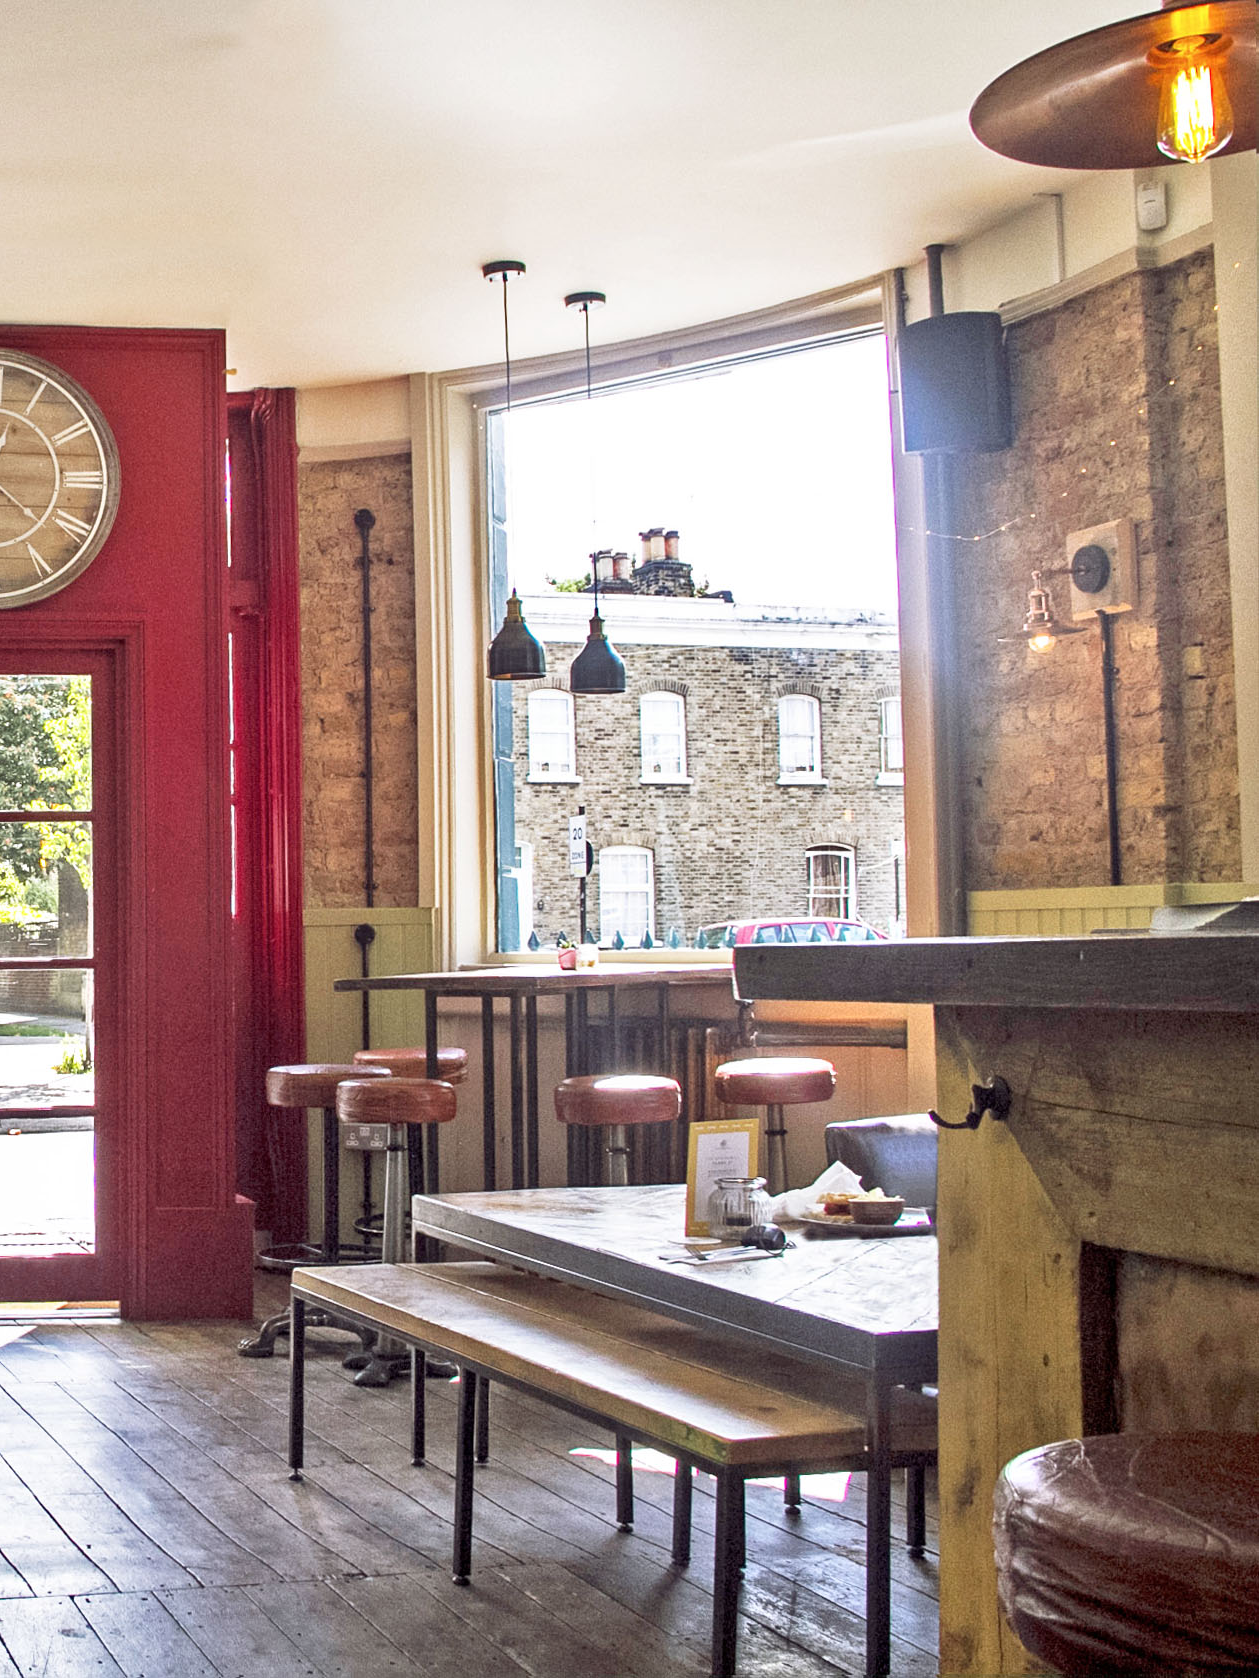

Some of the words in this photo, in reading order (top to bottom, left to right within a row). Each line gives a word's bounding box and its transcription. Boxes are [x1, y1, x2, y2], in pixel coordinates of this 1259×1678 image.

[23, 380, 47, 416] I
[51, 418, 91, 447] II
[63, 471, 102, 489] III
[25, 541, 53, 579] V
[573, 827, 583, 840] 20
